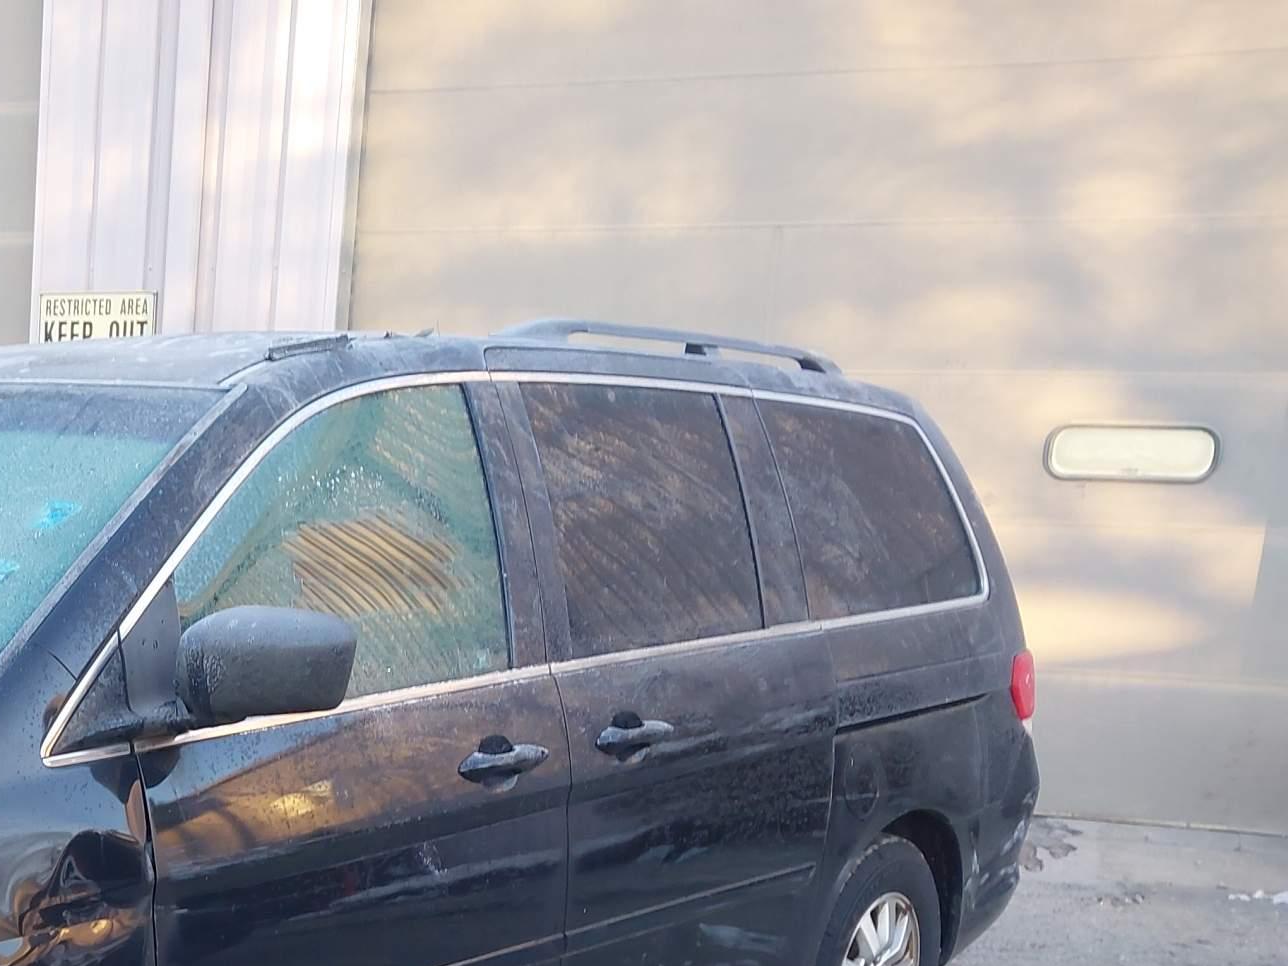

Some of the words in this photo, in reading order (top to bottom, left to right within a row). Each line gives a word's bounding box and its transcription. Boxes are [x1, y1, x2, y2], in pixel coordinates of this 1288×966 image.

[45, 298, 112, 316] RESTRICTED
[120, 297, 148, 315] AREA
[44, 320, 93, 342] KEEP
